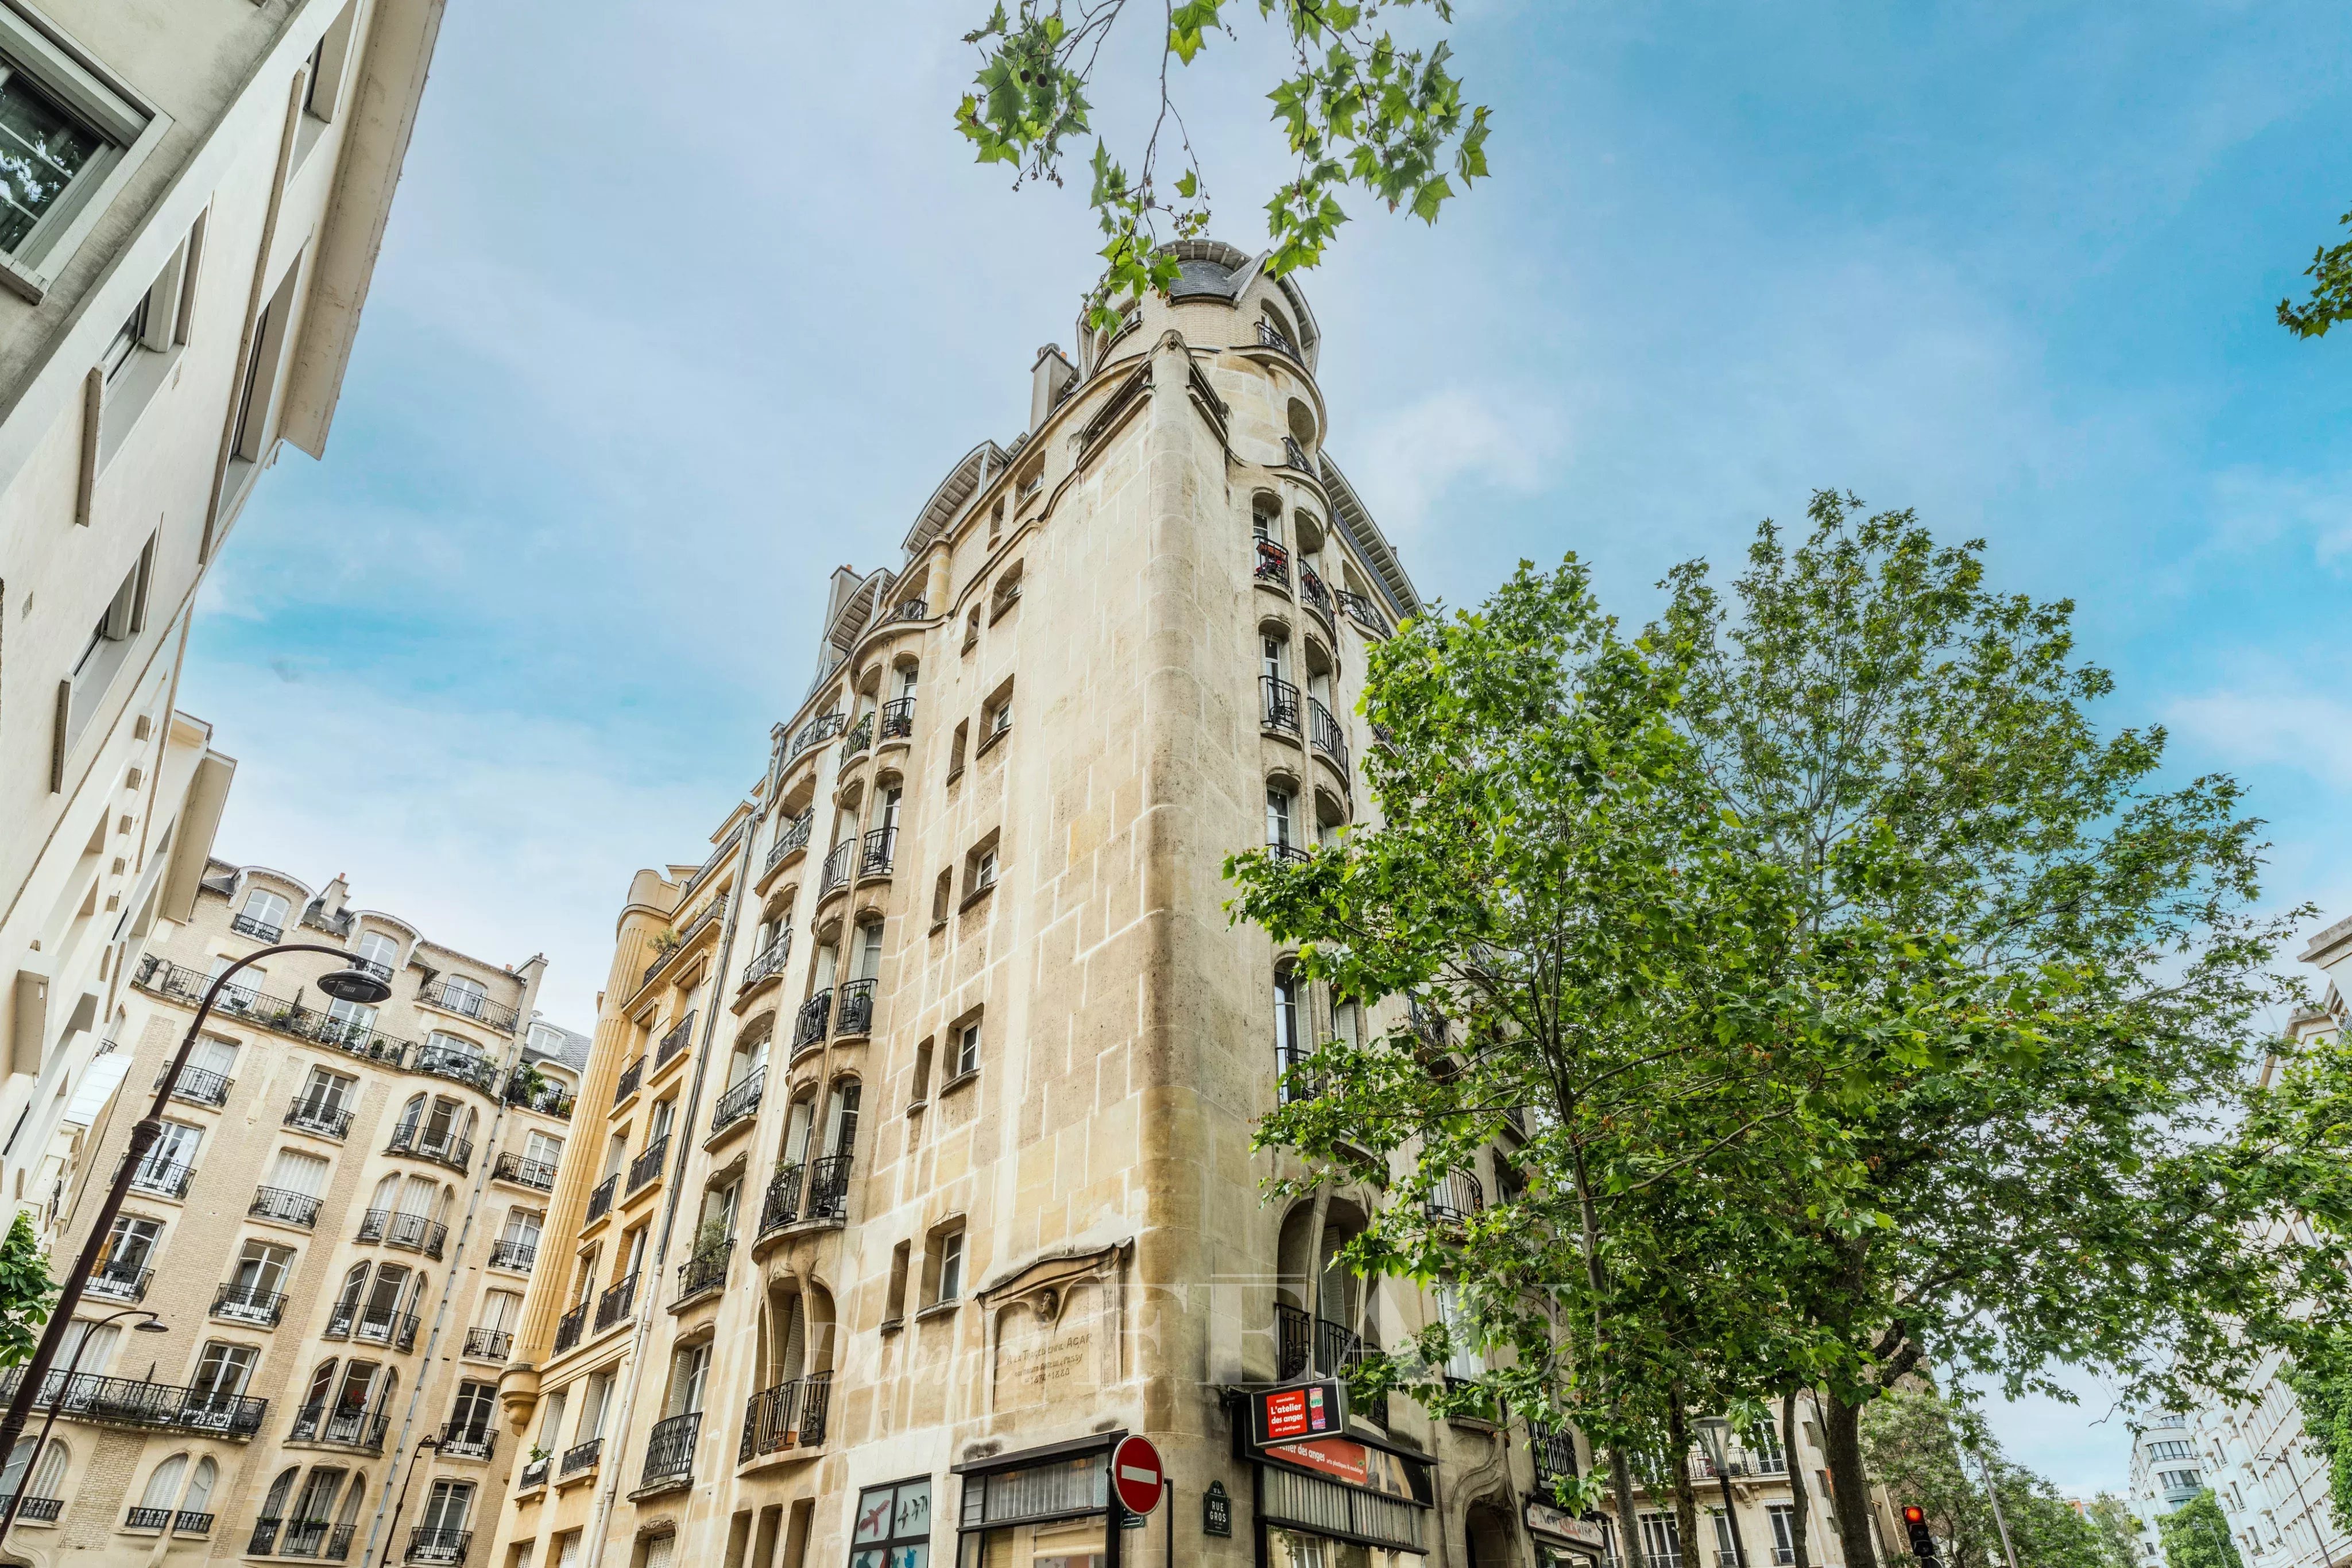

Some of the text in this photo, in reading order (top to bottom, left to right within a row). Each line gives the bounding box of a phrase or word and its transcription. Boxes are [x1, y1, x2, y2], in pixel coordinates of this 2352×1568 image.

[1063, 1353, 1082, 1365] PASSY
[1270, 1403, 1302, 1415] L'atelier
[1271, 1413, 1303, 1424] des anges
[1298, 1443, 1307, 1457] des
[1308, 1449, 1325, 1462] anges
[1212, 1501, 1224, 1512] RUE
[1209, 1511, 1227, 1523] GROS
